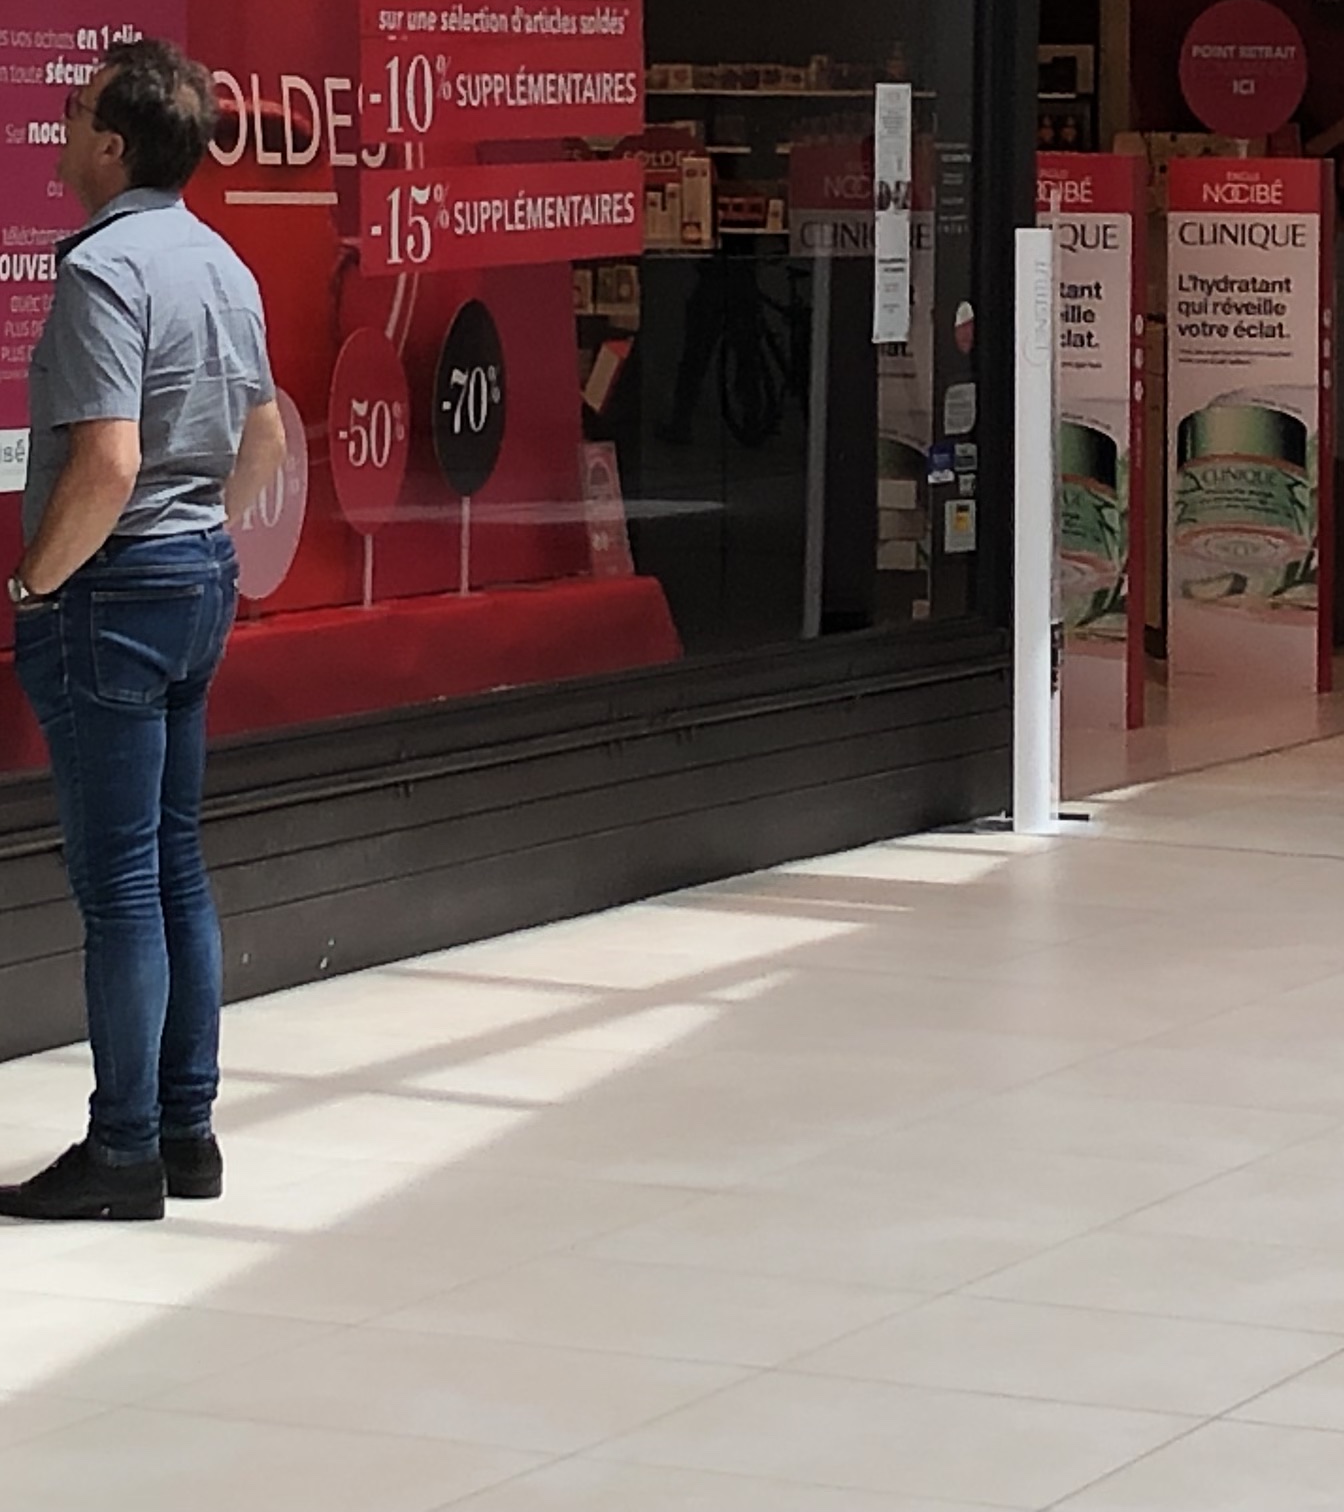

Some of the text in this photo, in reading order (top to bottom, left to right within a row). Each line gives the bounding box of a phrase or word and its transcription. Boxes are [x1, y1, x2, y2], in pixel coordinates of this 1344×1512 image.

[379, 8, 403, 32] sur
[407, 10, 438, 32] une
[440, 3, 507, 34] sélection
[511, 4, 577, 36] d'articles
[76, 27, 98, 51] en
[100, 24, 109, 51] 1
[1191, 45, 1236, 59] POINT
[368, 54, 638, 134] -10% SUPPLÉMENTAIRES
[1232, 79, 1255, 95] ICI
[370, 182, 636, 265] -15% SUPPLÉMENTAIRES
[1177, 221, 1307, 251] CLINIQUE
[1177, 273, 1293, 298] L'hydratant
[1177, 296, 1287, 318] qui réveille
[1176, 319, 1292, 340] votre éclat.
